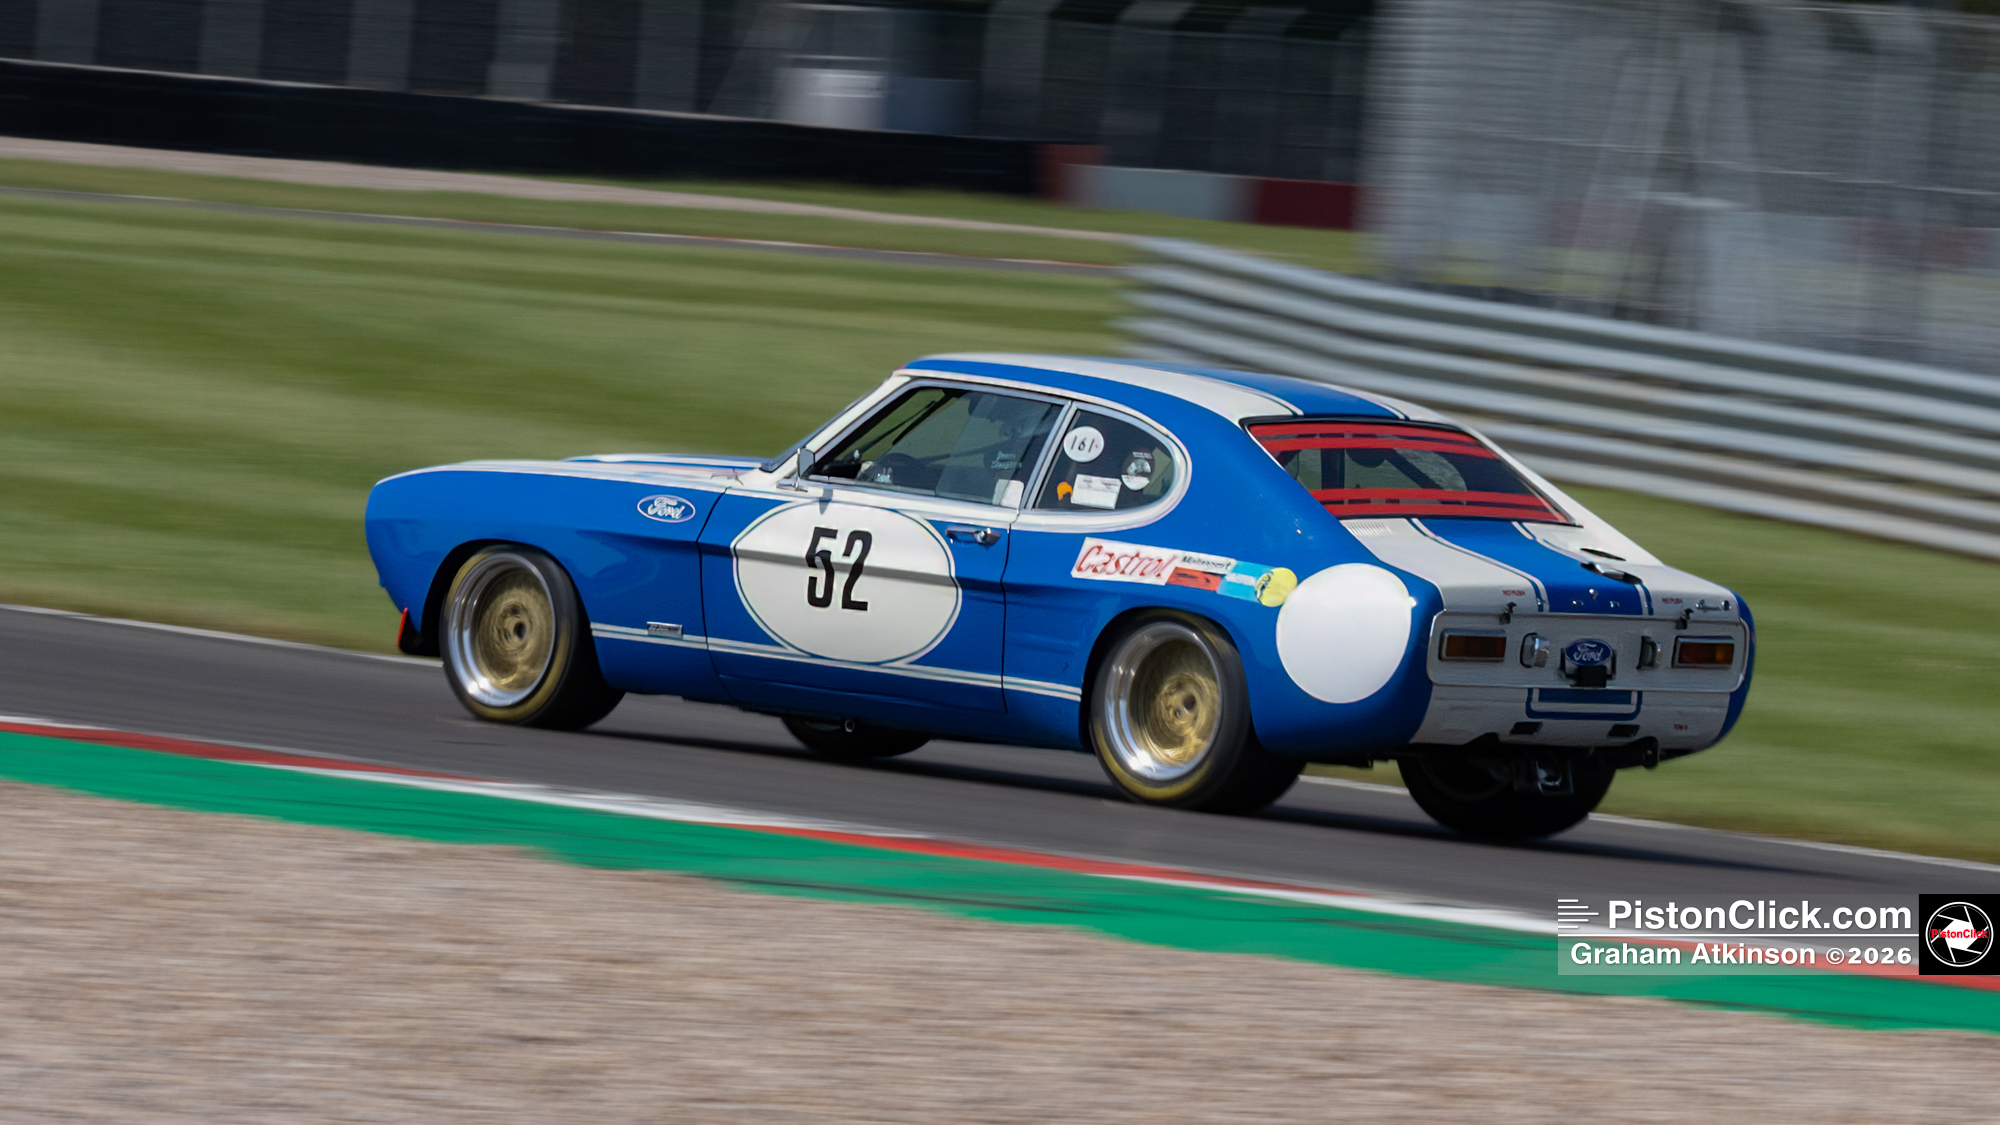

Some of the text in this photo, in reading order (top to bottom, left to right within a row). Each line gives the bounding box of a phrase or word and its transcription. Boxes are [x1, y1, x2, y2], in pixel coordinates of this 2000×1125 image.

[647, 497, 686, 519] Ford
[805, 526, 873, 611] 52
[1076, 545, 1178, 578] Castrol
[1573, 643, 1604, 661] Ford
